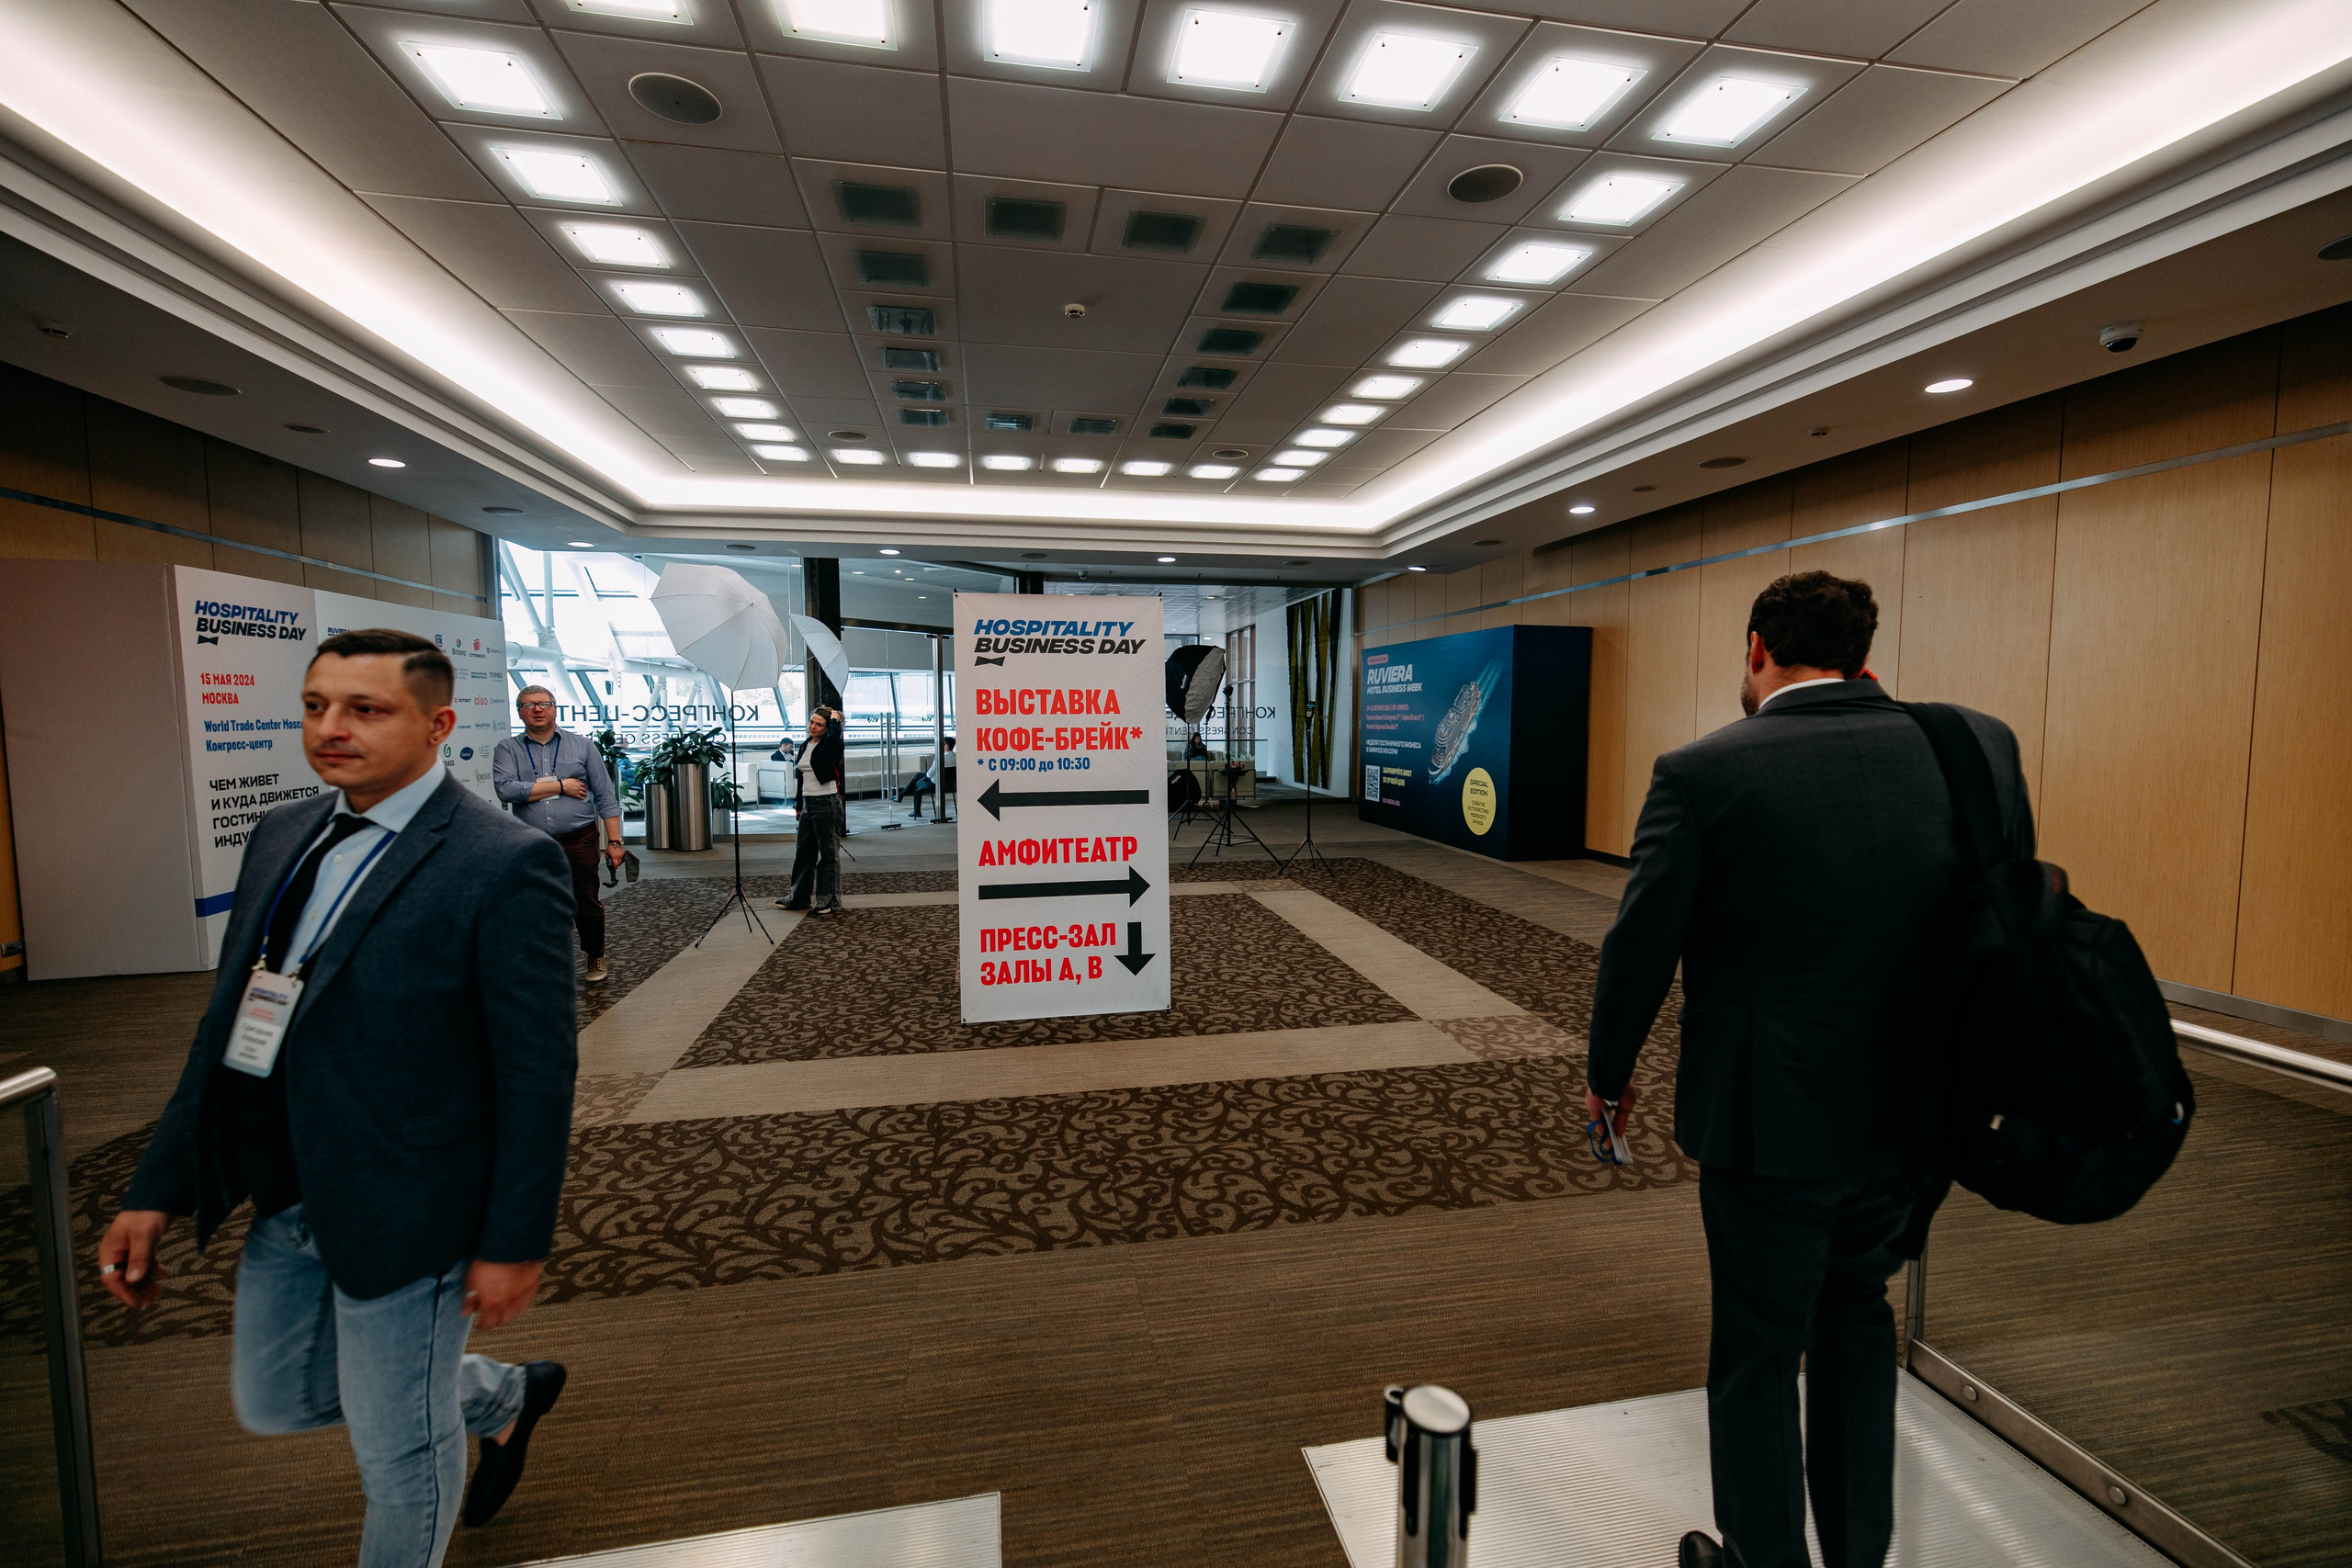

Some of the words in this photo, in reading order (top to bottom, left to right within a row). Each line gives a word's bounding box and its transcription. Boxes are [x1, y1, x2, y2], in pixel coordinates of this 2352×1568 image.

[194, 600, 299, 626] HOSPITALITY
[196, 617, 277, 638] BUSINESS
[278, 626, 307, 641] DAY
[974, 619, 1135, 637] HOSPITALITY
[452, 648, 467, 656] Bnovo
[974, 637, 1096, 654] BUSINESS
[1098, 638, 1147, 654] DAY
[200, 672, 211, 685] 15
[213, 672, 232, 685] МАЯ
[233, 674, 255, 686] 2024
[1367, 664, 1413, 684] RUVIERA
[1367, 686, 1381, 694] HOTEL
[1382, 684, 1407, 694] BUSINESS
[1407, 682, 1422, 692] WEEK
[202, 692, 239, 705] МОСКВА
[473, 694, 488, 705] aiso
[976, 689, 1121, 715] ВЫСТАВКА
[204, 719, 230, 732] World
[231, 719, 254, 732] Trade
[255, 718, 281, 730] Center
[206, 739, 273, 753] Конгресс-центр
[988, 758, 997, 771] С
[1000, 758, 1035, 771] 09:00
[1038, 760, 1054, 773] до
[1057, 757, 1091, 771] 10:30
[209, 777, 237, 792] ЧЕМ
[239, 773, 279, 789] ЖИВЕТ
[1470, 779, 1488, 787] SPECIAL
[211, 798, 220, 811] И
[223, 794, 257, 809] КУДА
[259, 786, 319, 807] ДВИЖЕТСЯ
[1470, 788, 1488, 796] EDITION
[212, 809, 270, 829] ГОСТИН
[214, 830, 250, 849] ИНДУ
[978, 836, 1138, 866] АМФИТЕАТР
[980, 922, 1116, 953] ПРЕСС-ЗАЛ
[980, 958, 1052, 986] ЗАЛЫ
